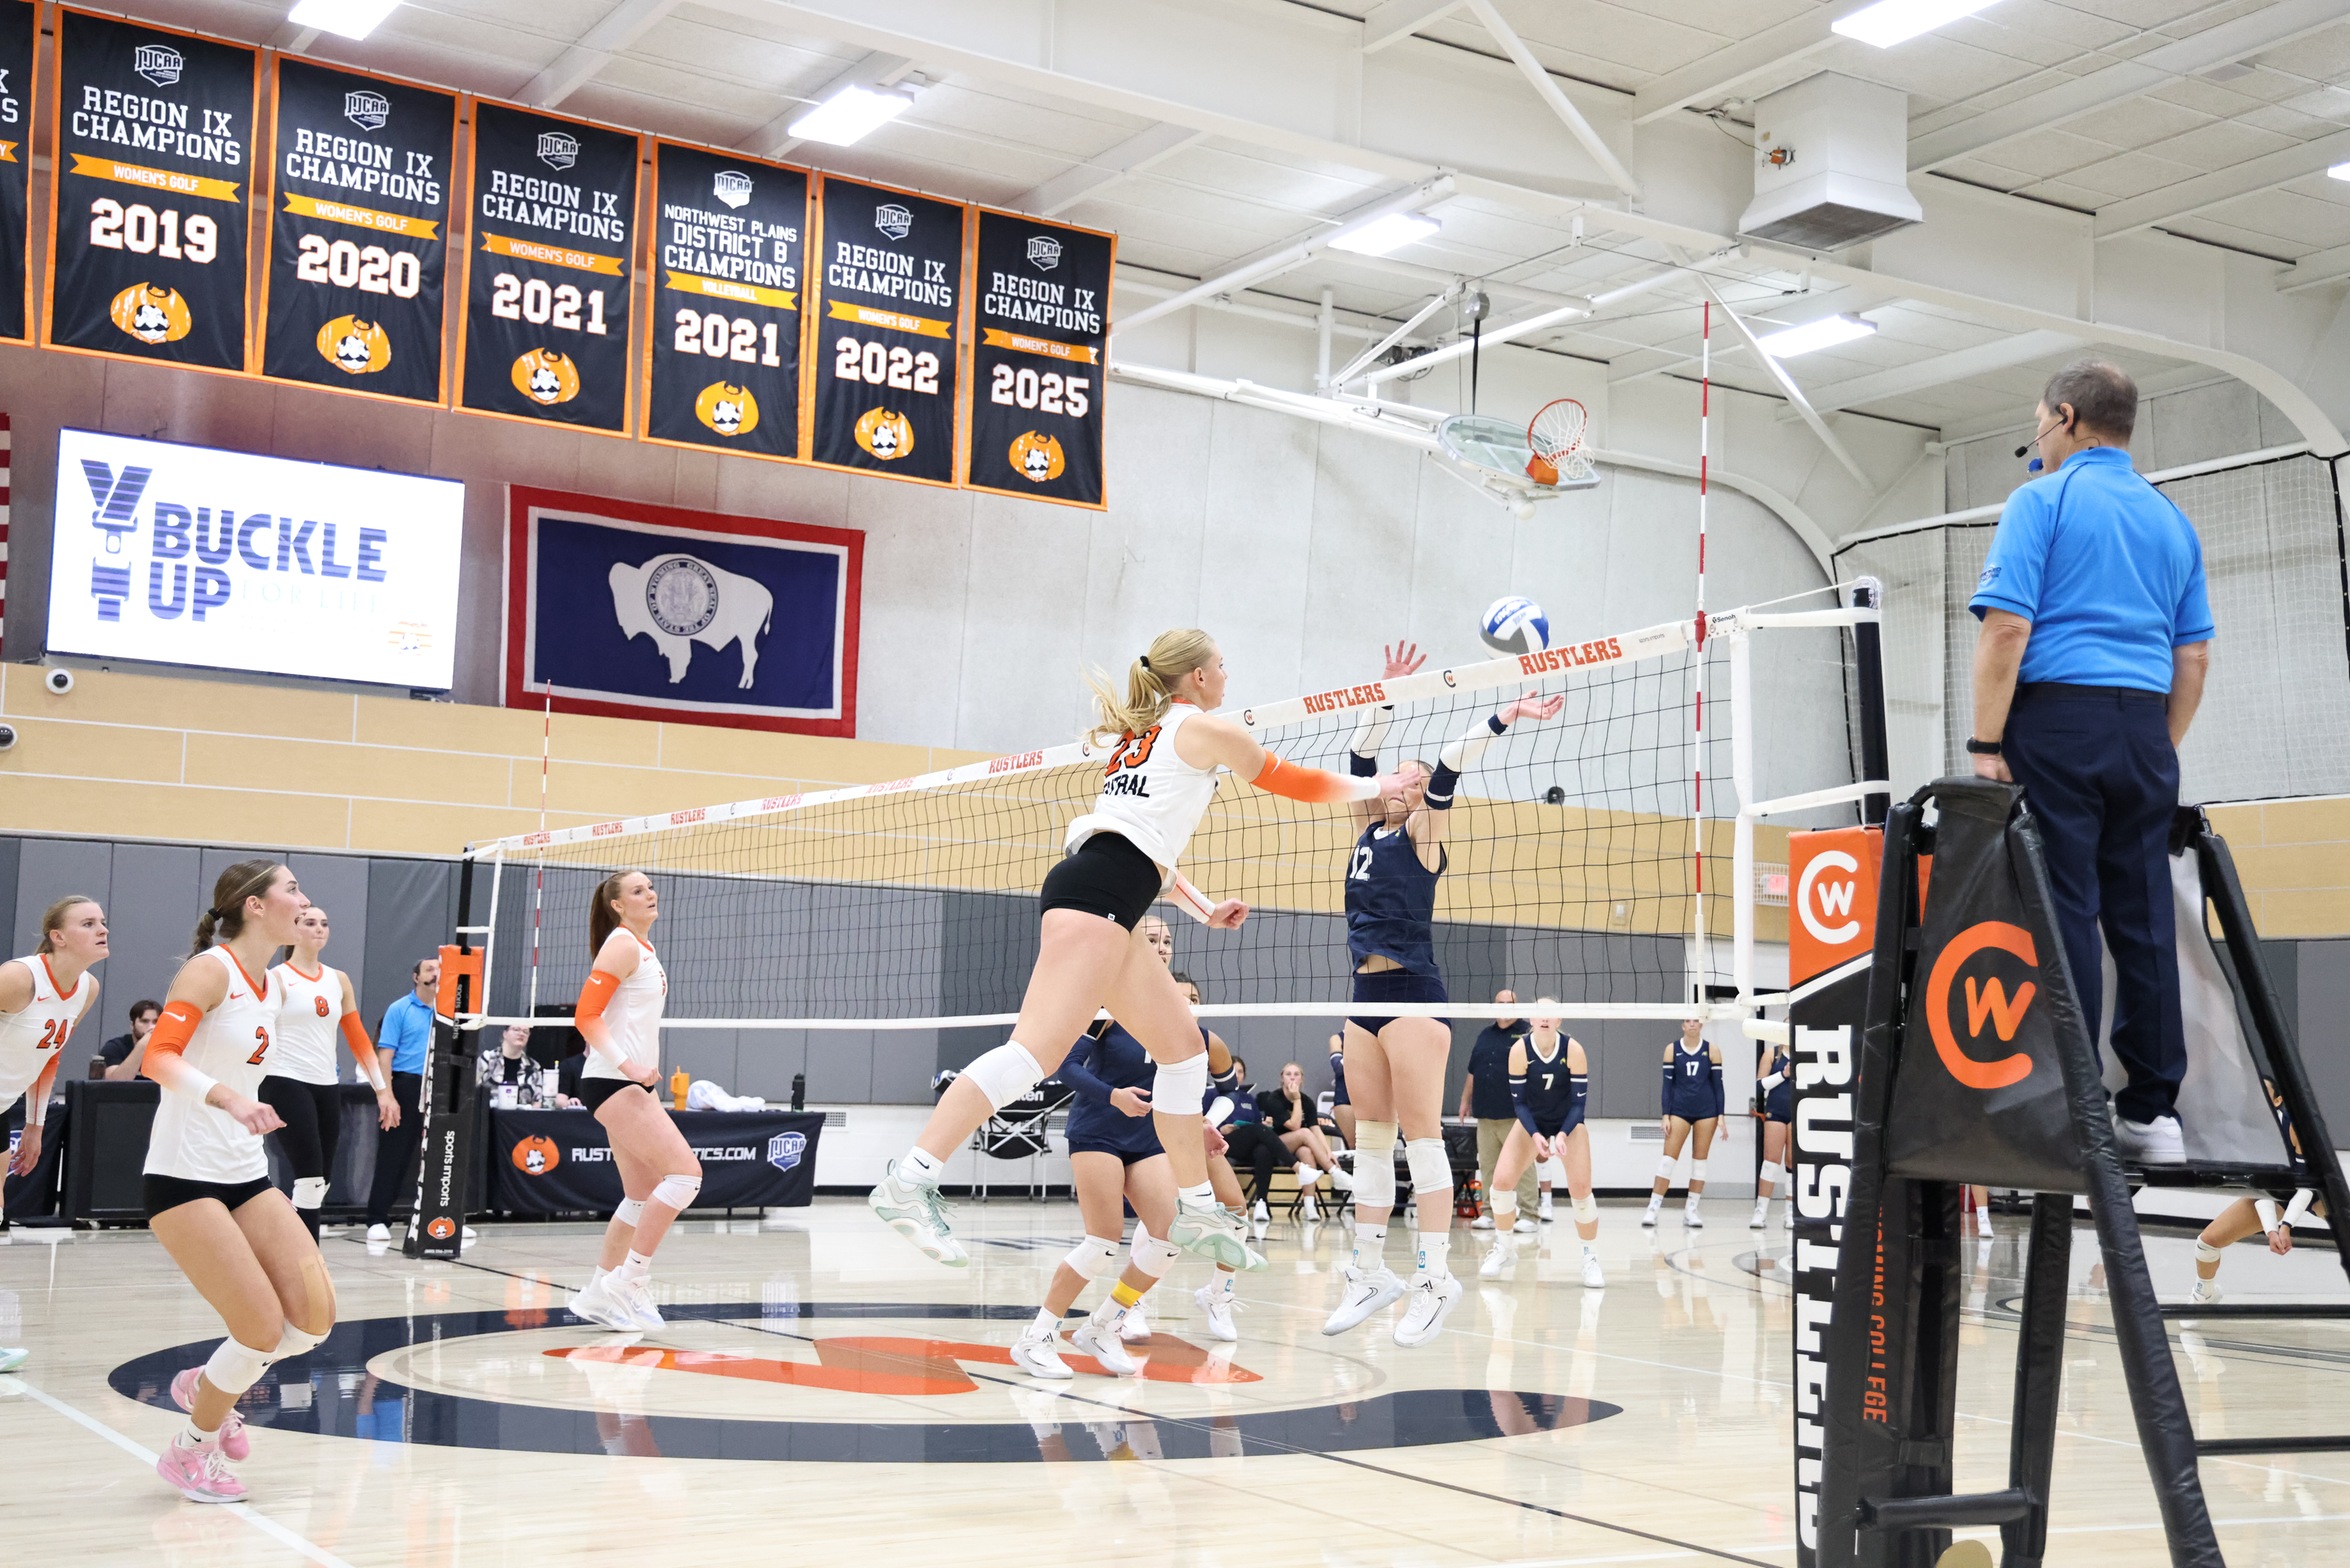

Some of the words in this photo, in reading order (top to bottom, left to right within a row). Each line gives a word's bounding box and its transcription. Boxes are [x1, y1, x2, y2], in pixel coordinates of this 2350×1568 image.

[137, 48, 181, 68] NJCAA
[83, 86, 188, 128] REGION
[203, 110, 232, 137] IX
[347, 94, 388, 114] NJCAA
[73, 111, 241, 165] CHAMPIONS
[295, 128, 393, 170] REGION
[406, 151, 433, 179] IX
[539, 135, 577, 155] NJCAA
[114, 165, 166, 186] WOMEN'S
[169, 172, 199, 192] GOLF
[286, 153, 440, 205] CHAMPIONS
[491, 170, 581, 209] REGION
[593, 191, 618, 217] IX
[716, 175, 751, 193] NJCAA
[90, 198, 218, 264] 2019
[315, 202, 373, 225] WOMEN'S
[376, 215, 408, 232] GOLF
[482, 194, 625, 242] CHAMPIONS
[665, 204, 745, 232] NORTHWEST
[752, 220, 797, 242] PLAINS
[877, 208, 911, 226] NJCAA
[509, 241, 563, 263] WOMEN'S
[566, 252, 595, 268] GOLF
[673, 222, 763, 259] DISTRICT
[774, 241, 788, 264] B
[1028, 240, 1061, 257] NJCAA
[297, 233, 421, 299] 2020
[664, 245, 795, 289] CHAMPIONS
[836, 241, 914, 277] REGION
[924, 260, 946, 283] IX
[492, 272, 607, 335] 2021
[701, 280, 757, 300] VOLLEYBALL
[829, 264, 952, 307] CHAMPIONS
[992, 272, 1065, 306] REGION
[1074, 287, 1095, 311] IX
[858, 309, 897, 327] WOMEN'S
[899, 317, 920, 331] GOLF
[985, 293, 1100, 334] CHAMPIONS
[674, 308, 780, 367] 2021
[1012, 336, 1048, 352] WOMEN'S
[1050, 343, 1071, 357] GOLF
[835, 336, 939, 395] 2022
[991, 363, 1089, 418] 2025
[152, 501, 388, 583] BUCKLE
[148, 561, 232, 623] UP
[1519, 637, 1623, 676] RUSTLERS
[1303, 682, 1386, 714] RUSTLERS
[988, 750, 1043, 774] RUSTLERS
[1104, 725, 1162, 778] 23
[761, 794, 804, 811] RUSTLERS
[866, 777, 916, 794] RUSTLERS
[592, 822, 623, 837] RUSTLERS
[671, 808, 706, 825] RUSTLERS
[1350, 845, 1373, 881] 12
[314, 995, 330, 1017] 8
[36, 1018, 68, 1050] 24
[246, 1025, 269, 1066] 2
[1541, 1073, 1554, 1090] 7
[1685, 1061, 1699, 1076] 17
[443, 1130, 455, 1164] sports
[769, 1138, 806, 1160] NJCAA
[440, 1165, 452, 1207] imports
